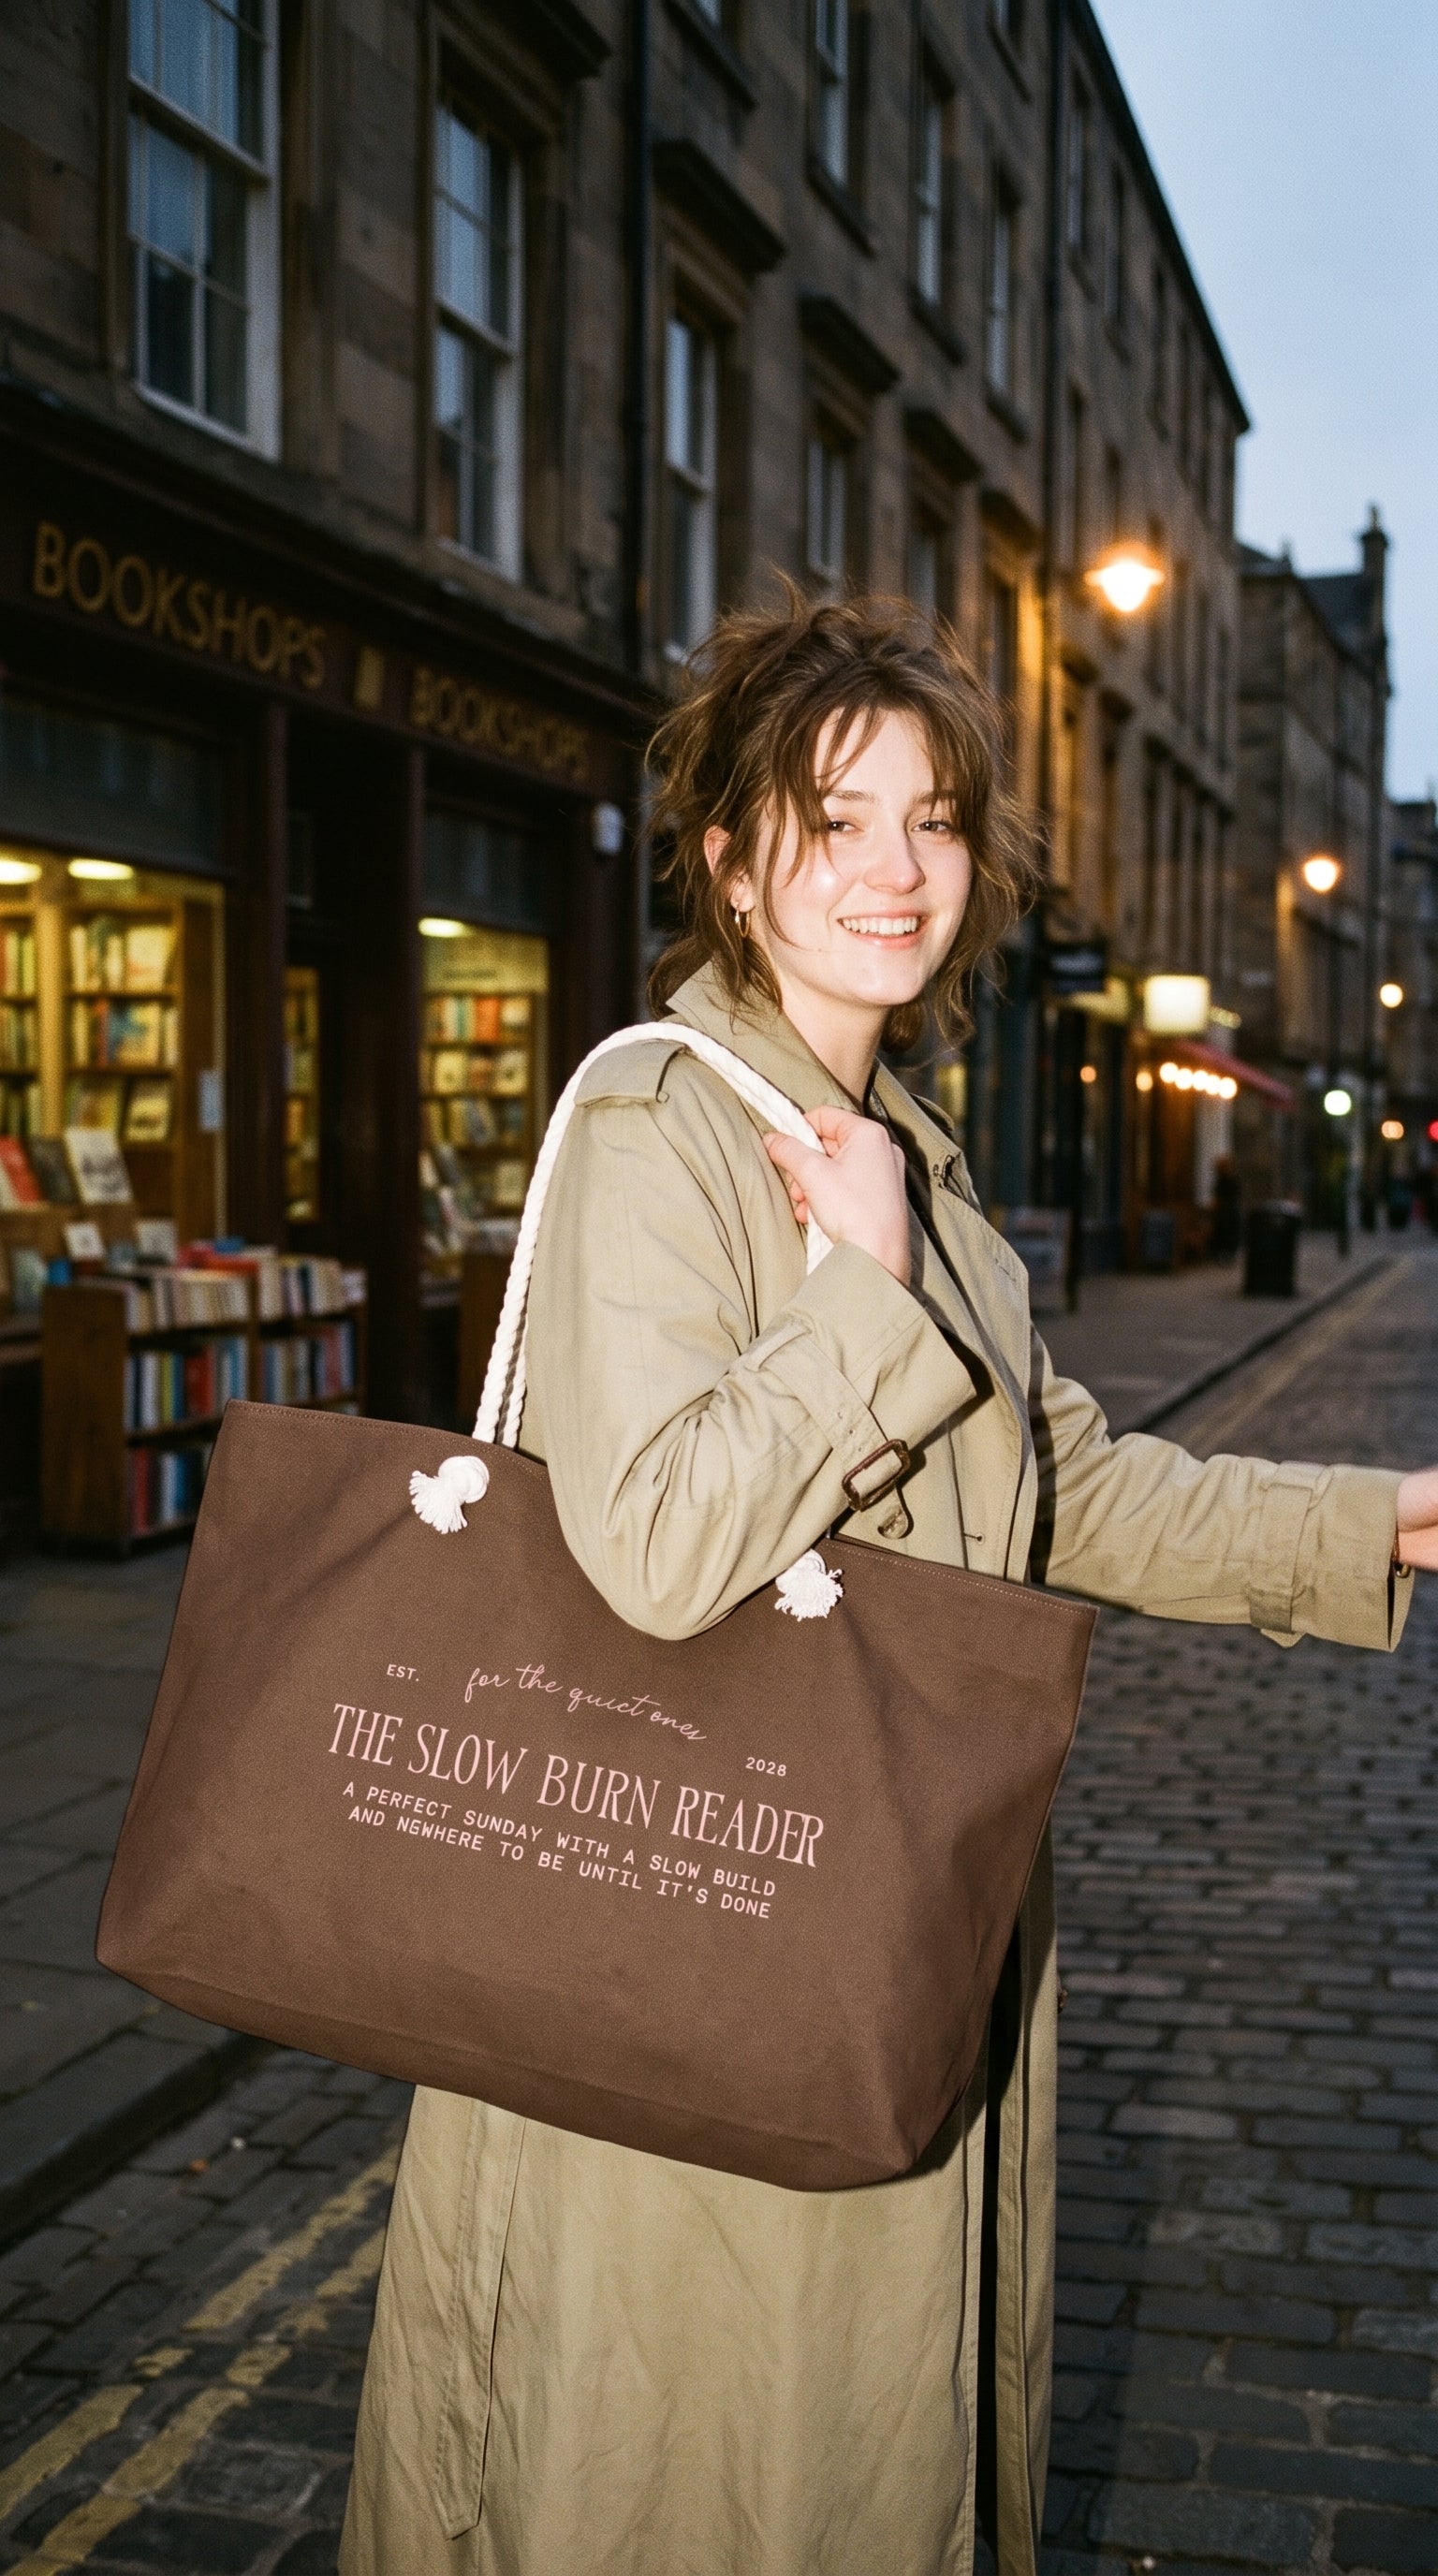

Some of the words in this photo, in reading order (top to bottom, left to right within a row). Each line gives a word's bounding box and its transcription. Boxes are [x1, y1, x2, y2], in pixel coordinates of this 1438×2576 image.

[32, 520, 328, 691] BOOKSHOPS
[386, 1663, 420, 1682] EST.
[463, 1667, 510, 1704] for
[516, 1663, 564, 1693] the
[650, 1710, 708, 1740] ones
[328, 1703, 404, 1767] THE
[407, 1723, 529, 1795] SLOW
[536, 1753, 662, 1830] BURN
[669, 1785, 826, 1869] READER
[745, 1756, 788, 1778] 2028
[343, 1781, 355, 1798] A
[366, 1786, 453, 1820] PERFECT
[462, 1809, 544, 1843] SUNDAY
[556, 1831, 610, 1860] WITH
[622, 1849, 635, 1866] A
[649, 1854, 702, 1881] SLOW
[712, 1867, 776, 1897] BUILD
[347, 1805, 387, 1827] AND
[500, 1840, 524, 1862] TO
[537, 1851, 565, 1872] BE
[579, 1860, 642, 1891] UNTIL
[656, 1879, 709, 1905] IT'S
[720, 1893, 771, 1919] DONE
